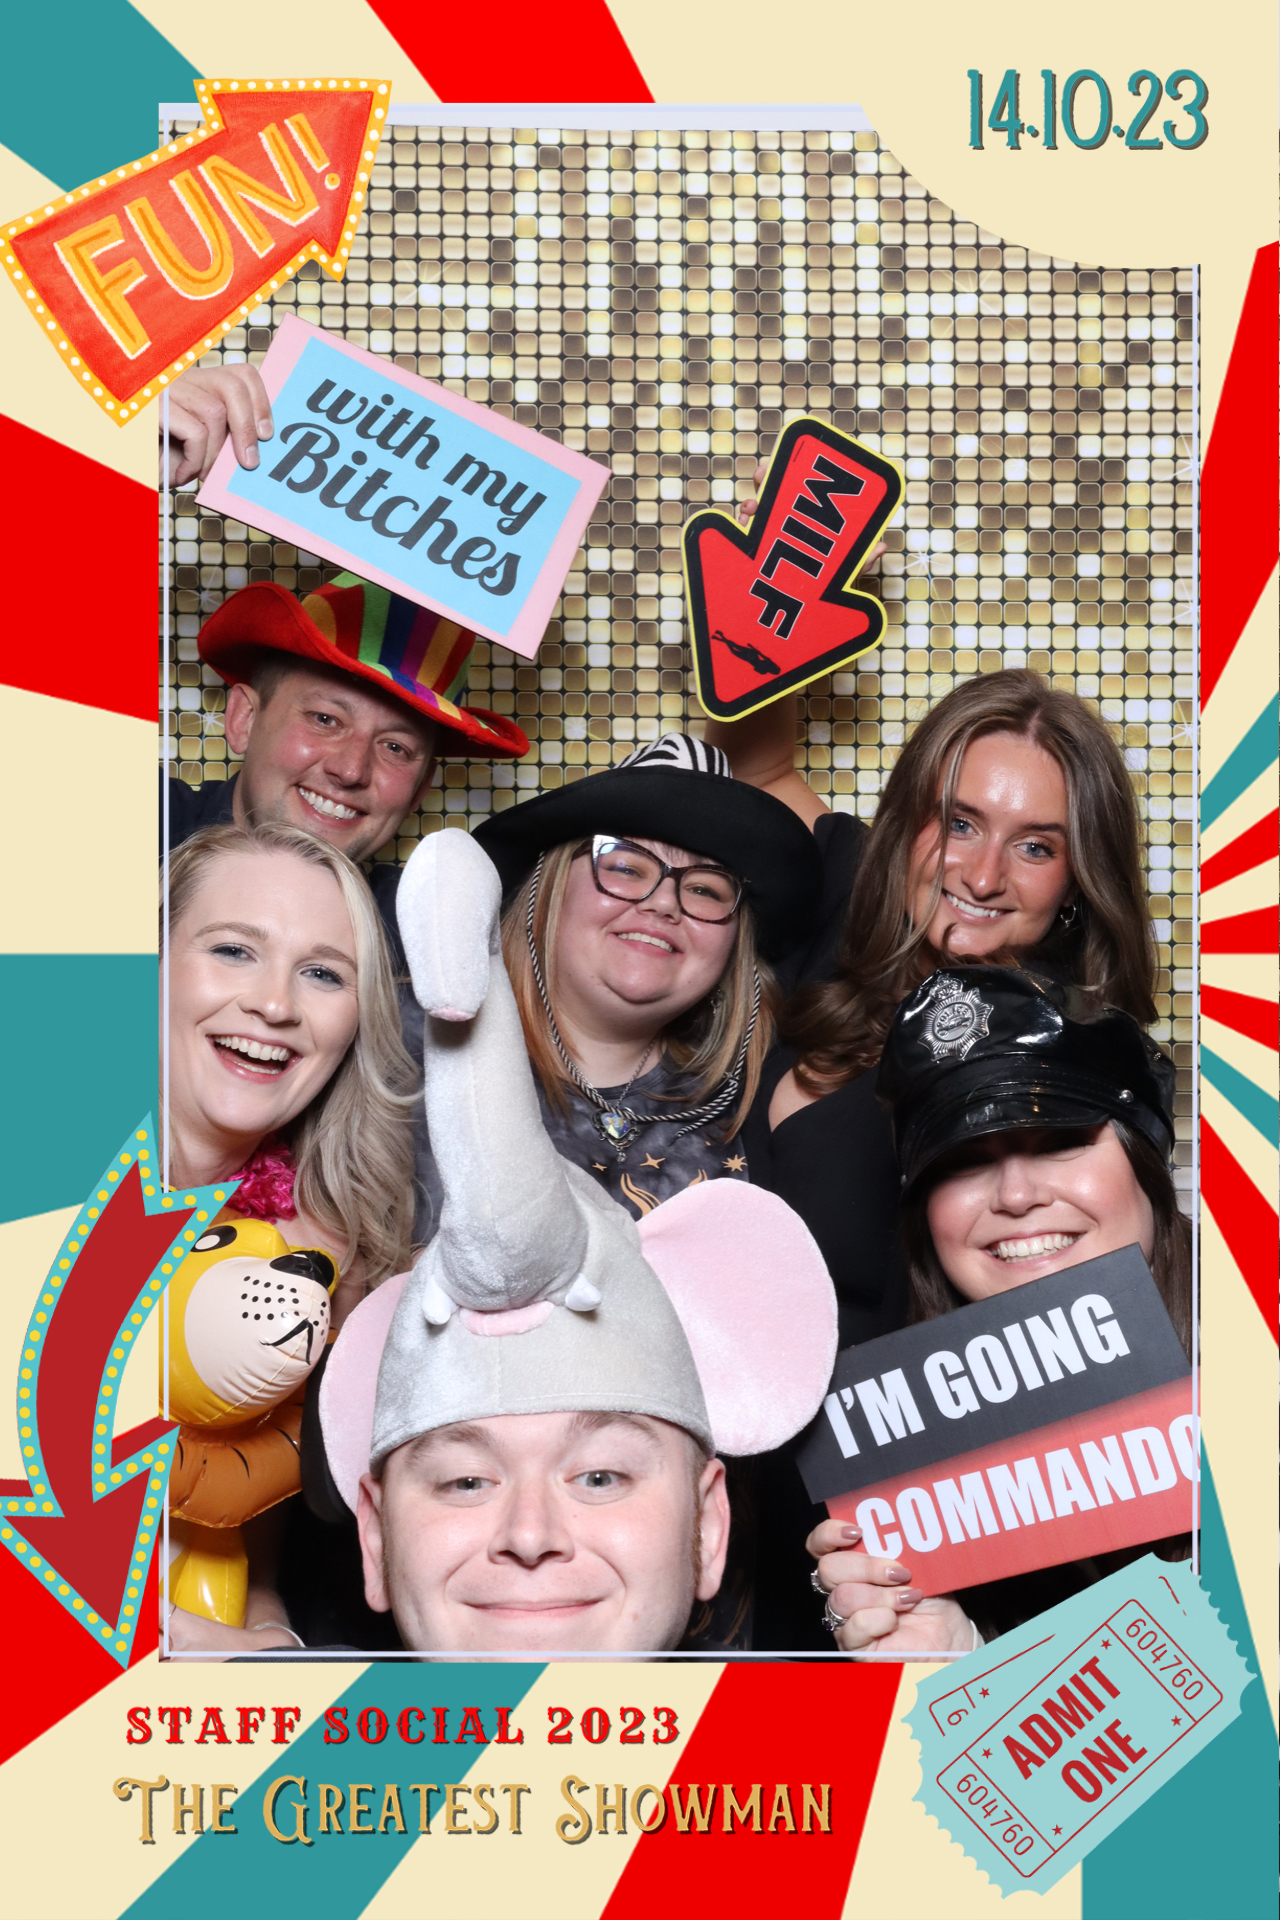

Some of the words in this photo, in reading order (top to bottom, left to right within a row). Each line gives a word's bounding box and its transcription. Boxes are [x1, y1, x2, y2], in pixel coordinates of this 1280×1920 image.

[268, 422, 521, 596] Bitches
[306, 378, 440, 470] with
[443, 453, 548, 536] my
[749, 454, 866, 640] MILF
[824, 1368, 925, 1459] I'M
[923, 1294, 1131, 1419] GOING
